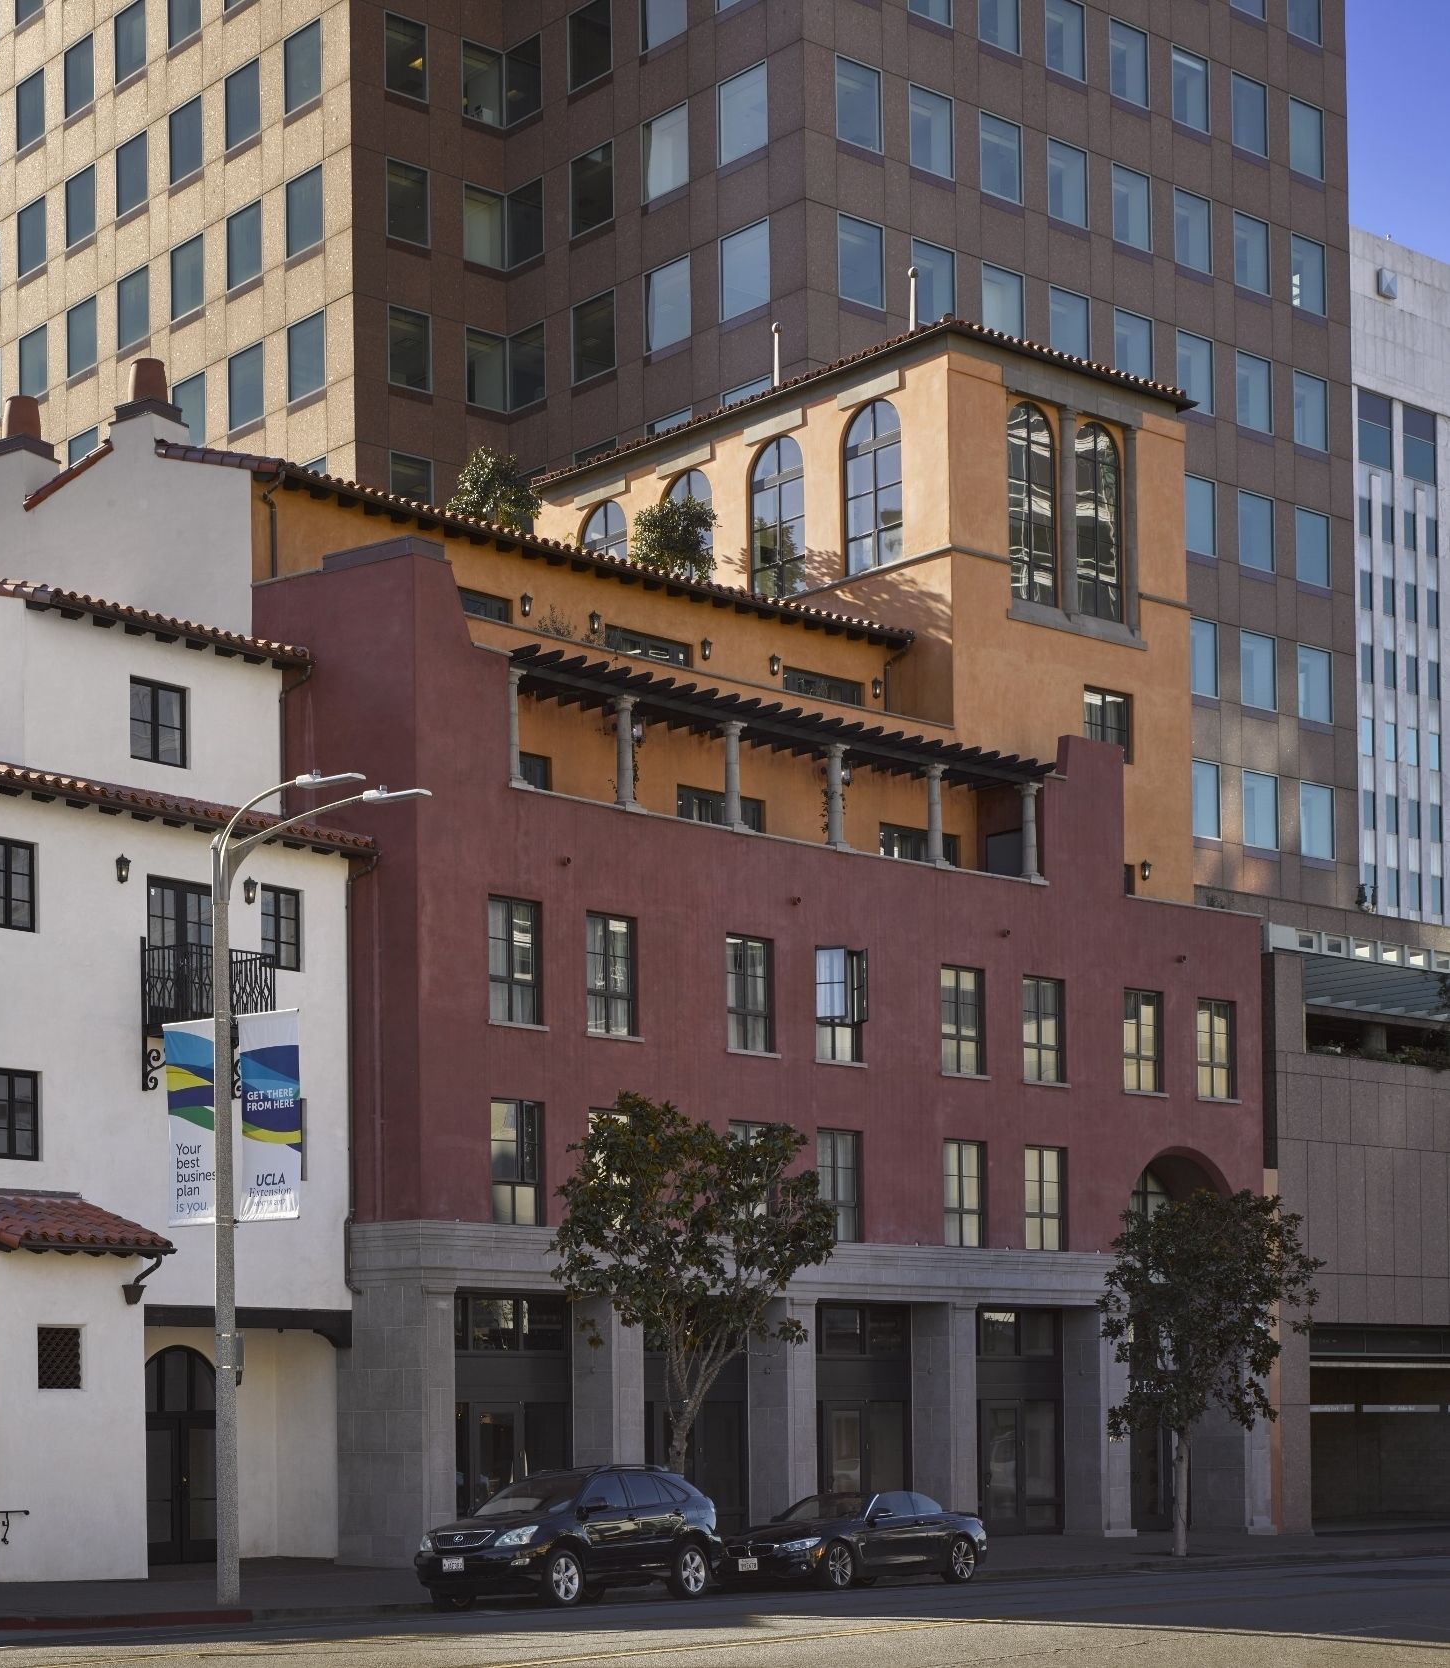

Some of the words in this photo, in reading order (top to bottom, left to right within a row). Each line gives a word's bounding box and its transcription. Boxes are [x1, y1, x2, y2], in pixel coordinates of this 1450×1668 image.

[247, 1090, 264, 1101] GET
[267, 1088, 294, 1099] THERE
[246, 1101, 272, 1111] FROM
[273, 1099, 294, 1109] HERE
[175, 1143, 202, 1155] Your
[176, 1157, 200, 1169] best
[176, 1170, 216, 1183] busines
[256, 1172, 286, 1186] UCLA
[176, 1185, 200, 1199] plan
[249, 1186, 292, 1198] Extension
[176, 1201, 185, 1213] is
[187, 1202, 209, 1214] you.
